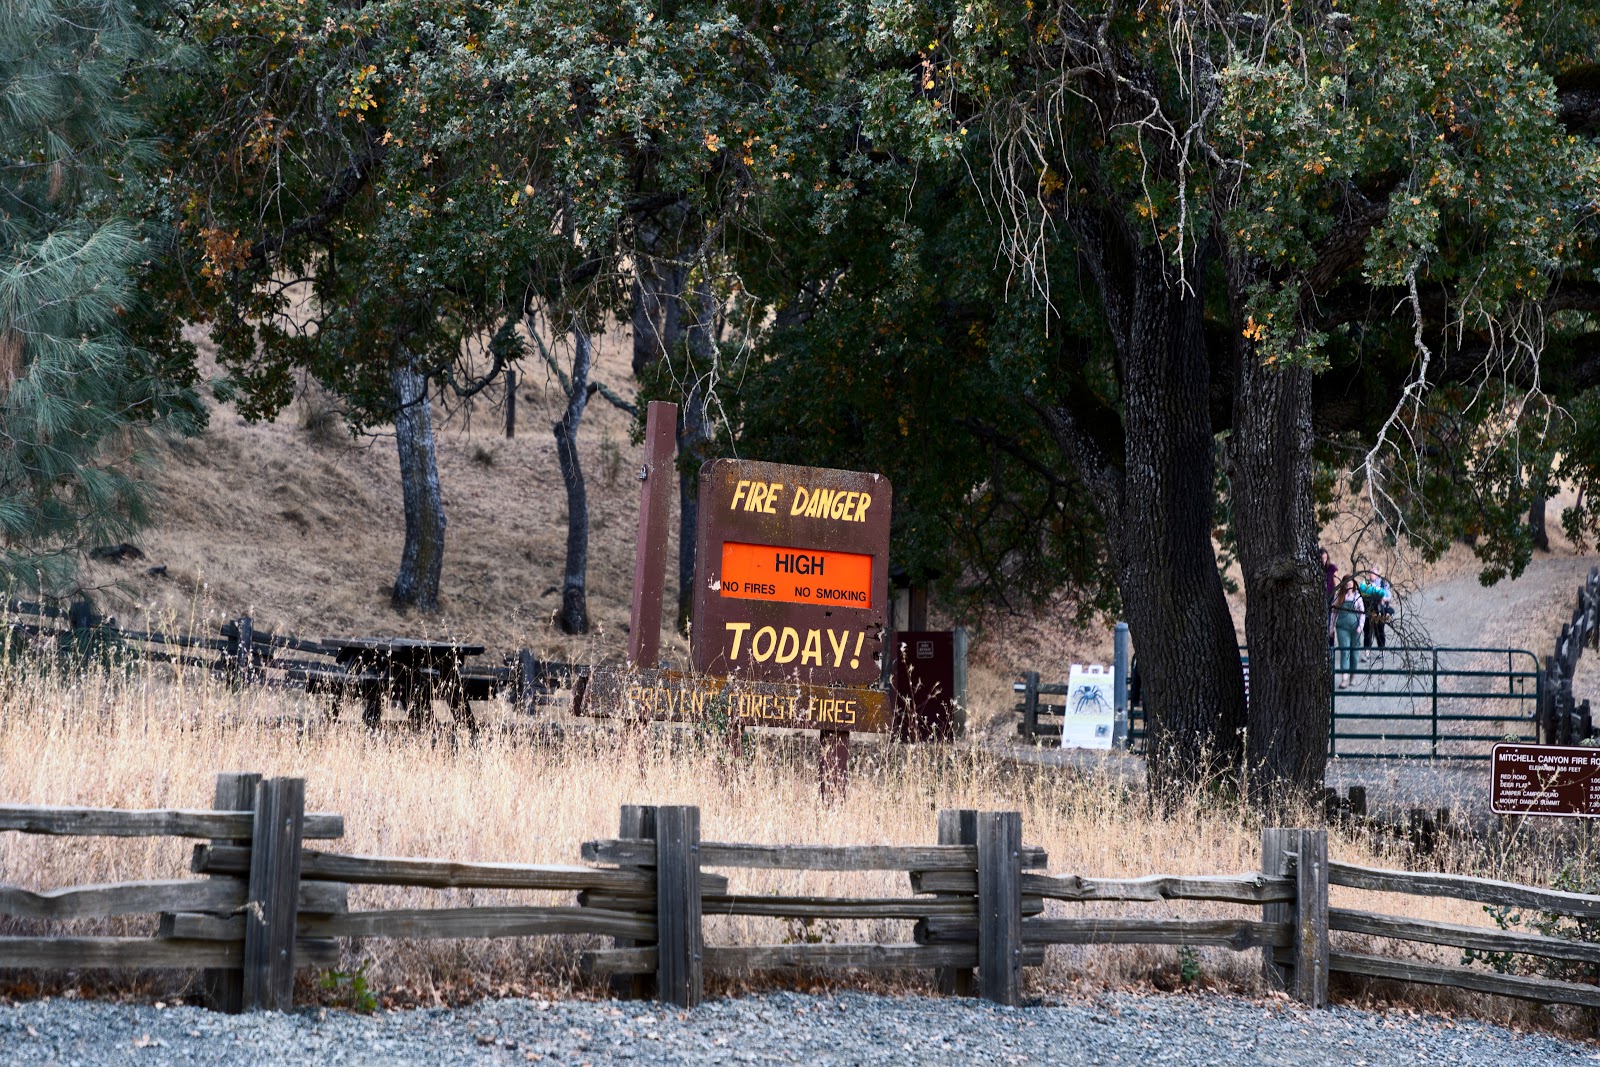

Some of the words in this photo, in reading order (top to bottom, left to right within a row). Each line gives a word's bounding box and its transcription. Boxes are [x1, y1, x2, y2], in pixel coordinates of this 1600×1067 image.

[730, 480, 783, 514] FIRE
[790, 486, 872, 522] DANGER
[775, 553, 824, 576] HIGH
[722, 581, 739, 592] NO
[744, 583, 776, 595] FIRES
[794, 587, 811, 597] NO
[816, 588, 867, 602] SMOKING
[725, 622, 865, 670] TODAY!
[808, 698, 857, 723] FIRES
[1499, 753, 1535, 762] MITCHELL
[1538, 755, 1569, 764] CANYON
[1571, 757, 1588, 765] FIRE
